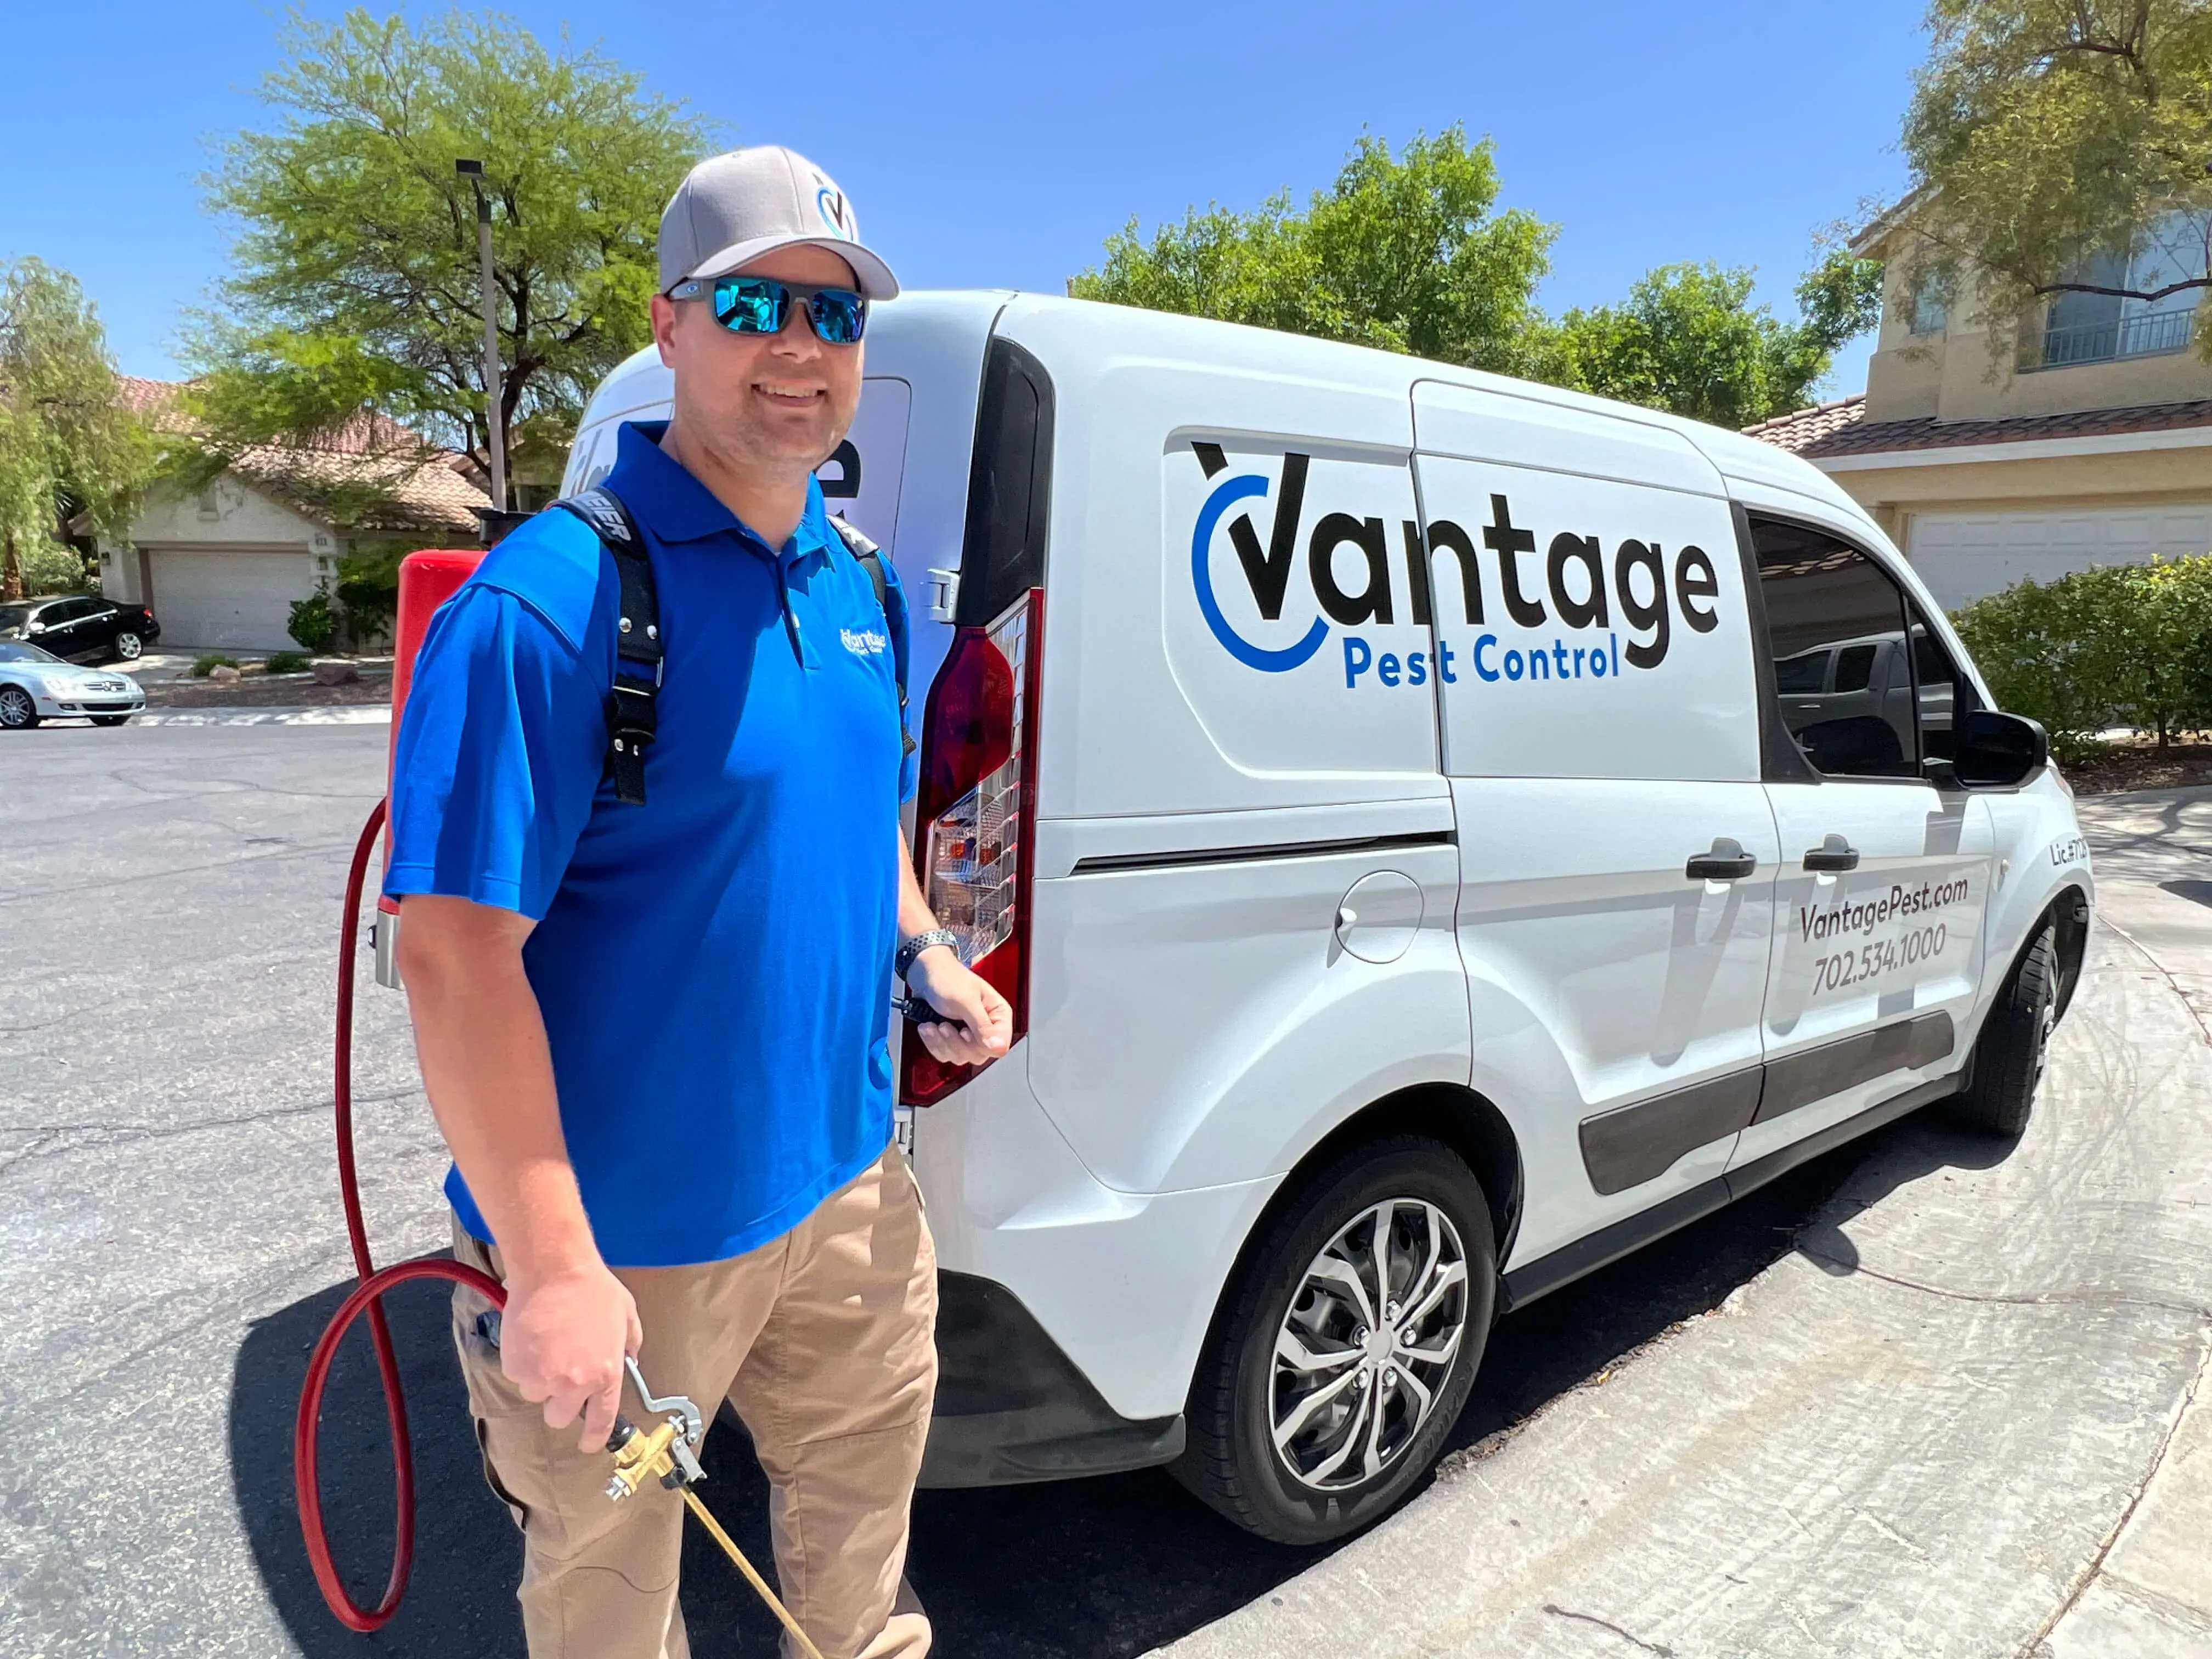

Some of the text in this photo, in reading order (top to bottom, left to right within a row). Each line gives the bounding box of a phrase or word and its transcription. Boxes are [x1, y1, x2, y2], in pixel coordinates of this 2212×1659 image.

[1191, 441, 1719, 670] Vantage
[1342, 633, 1619, 689] Pest Control
[1801, 879, 1968, 943] VantagePest.com
[1813, 923, 1946, 996] 702.534.1000
